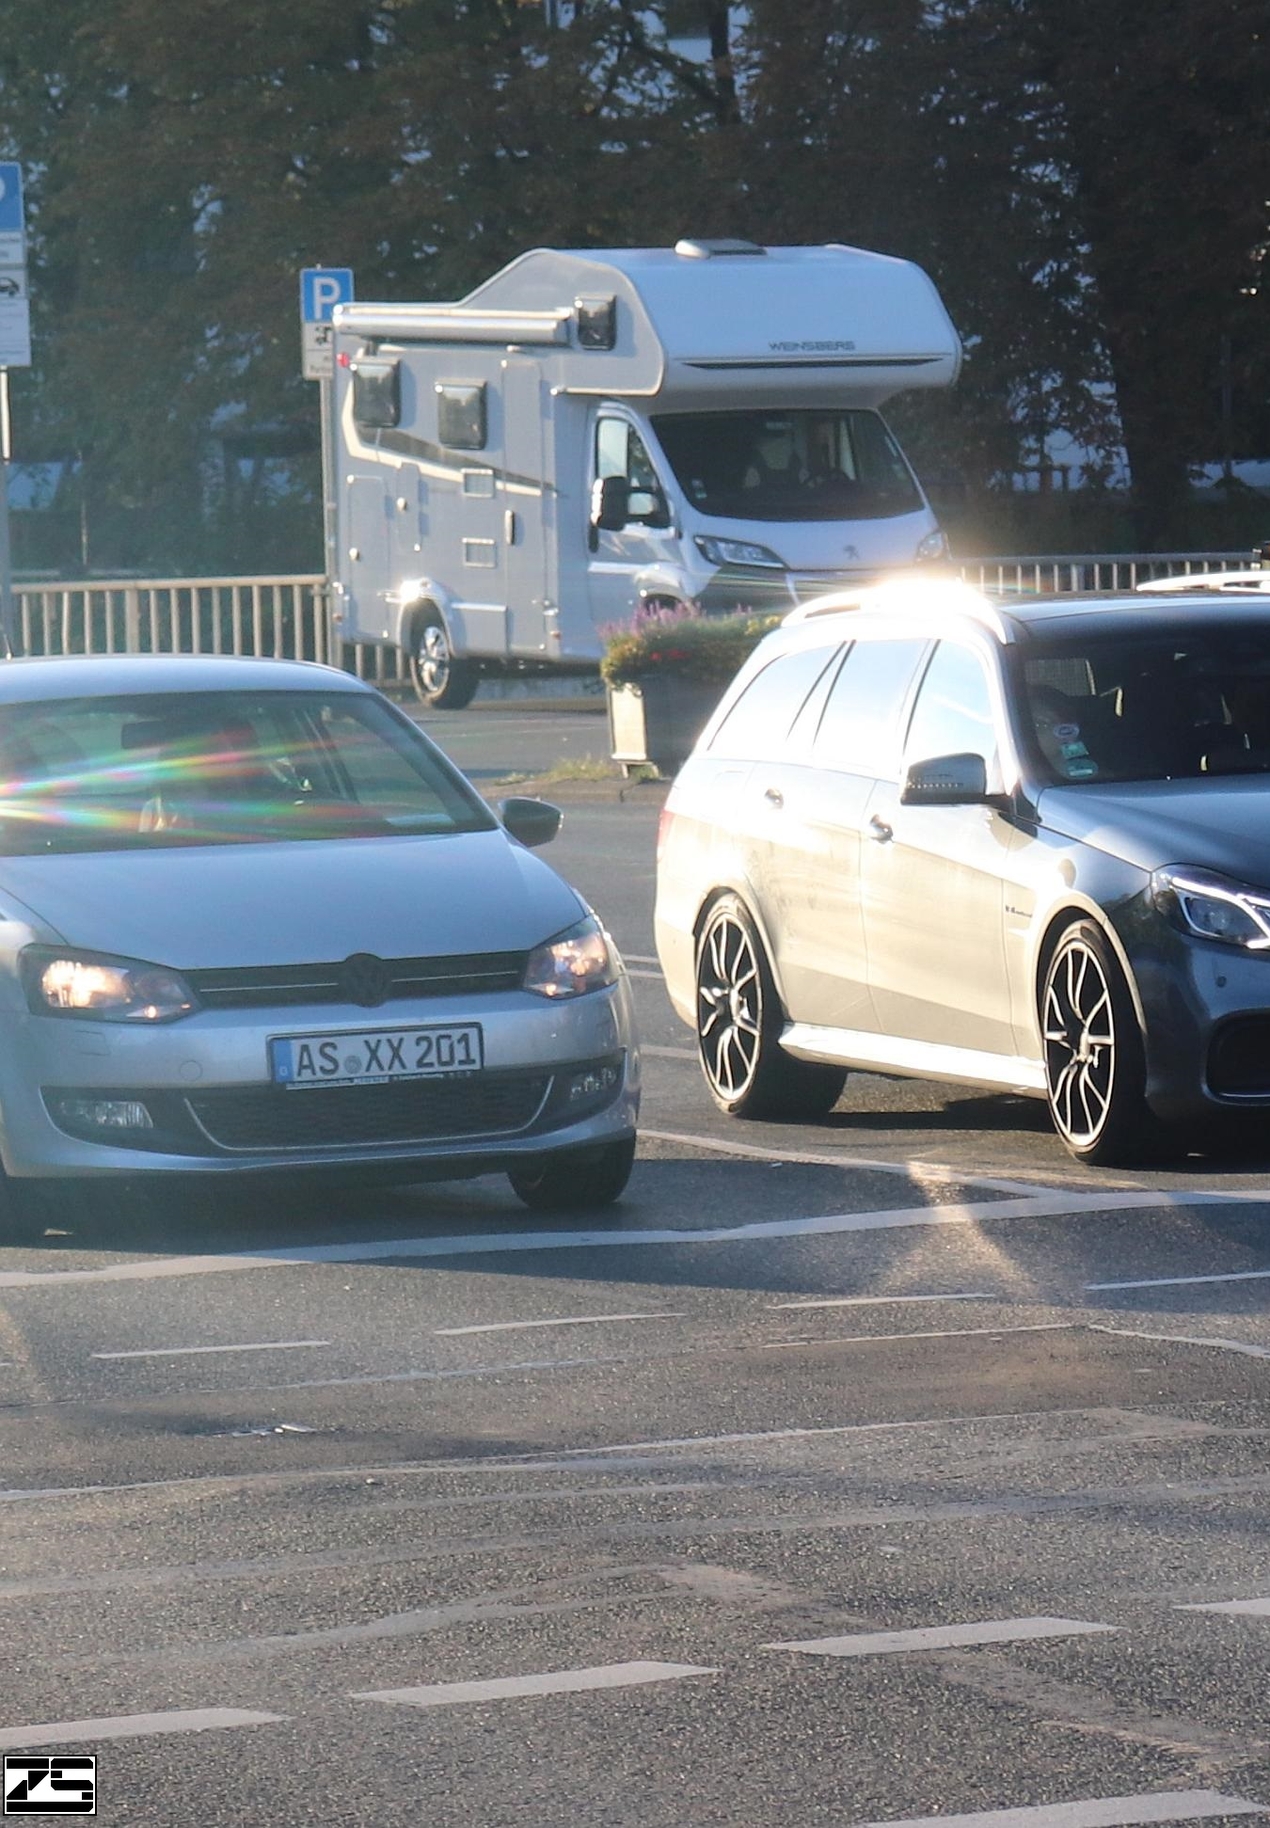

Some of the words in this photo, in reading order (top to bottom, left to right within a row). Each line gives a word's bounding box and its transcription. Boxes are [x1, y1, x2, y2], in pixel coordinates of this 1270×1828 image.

[313, 276, 341, 320] P
[297, 1042, 340, 1077] AS
[364, 1037, 407, 1072] XX
[415, 1033, 476, 1069] 201
